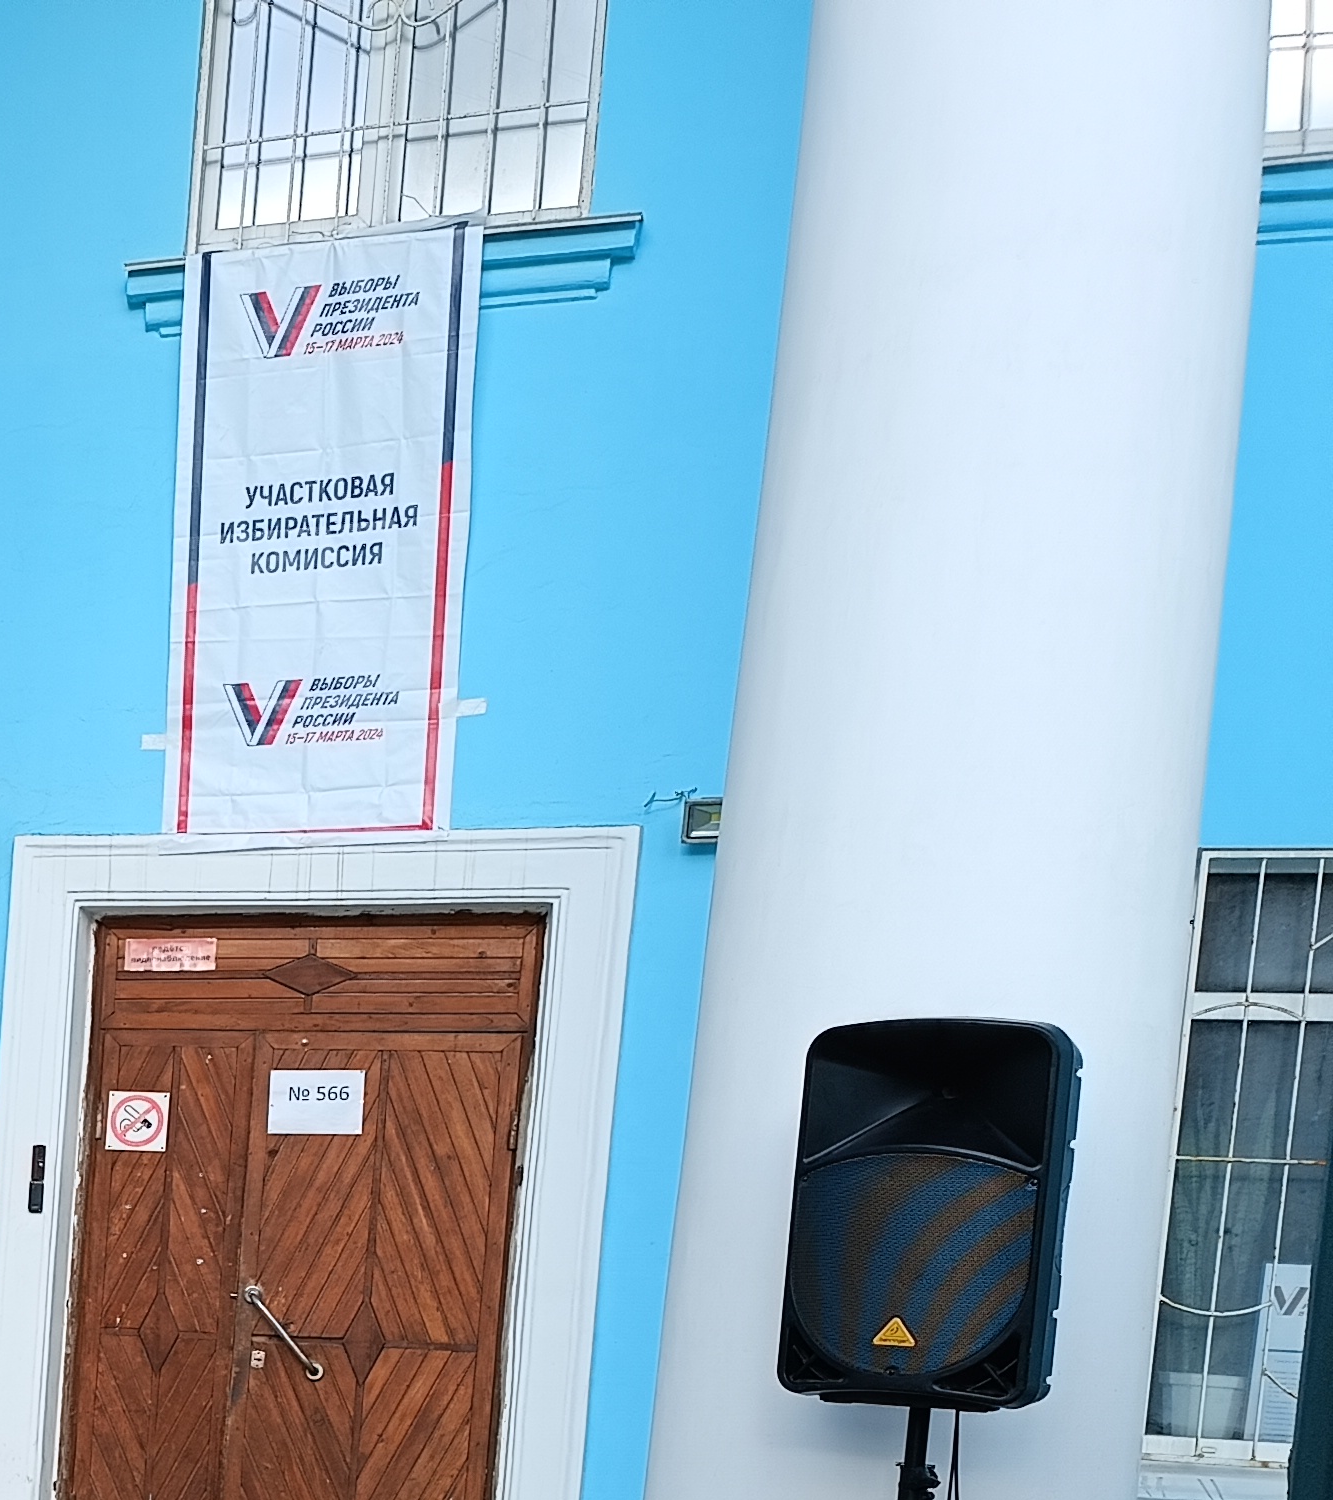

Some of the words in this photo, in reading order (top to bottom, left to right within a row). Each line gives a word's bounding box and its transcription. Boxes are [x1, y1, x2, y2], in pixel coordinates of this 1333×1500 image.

[328, 274, 400, 298] ВЫБОРЫ
[319, 291, 420, 317] ПРЕЗИДЕНТА
[310, 317, 375, 337] РОССИИ
[335, 335, 375, 352] МАРТА
[375, 331, 404, 347] 2024
[245, 472, 395, 509] УЧАСТКОВАЯ
[219, 504, 418, 544] ИЗБИРАТЕЛЬНАЯ
[250, 542, 383, 575] КОМИССИЯ
[309, 674, 380, 692] ВЫБОРЫ
[300, 691, 400, 711] ПРЕЗИДЕНТА
[292, 712, 356, 728] РОССИИ
[316, 729, 355, 743] МАРТА
[355, 728, 384, 741] 2024
[289, 1086, 310, 1102] №
[316, 1085, 351, 1101] 566
